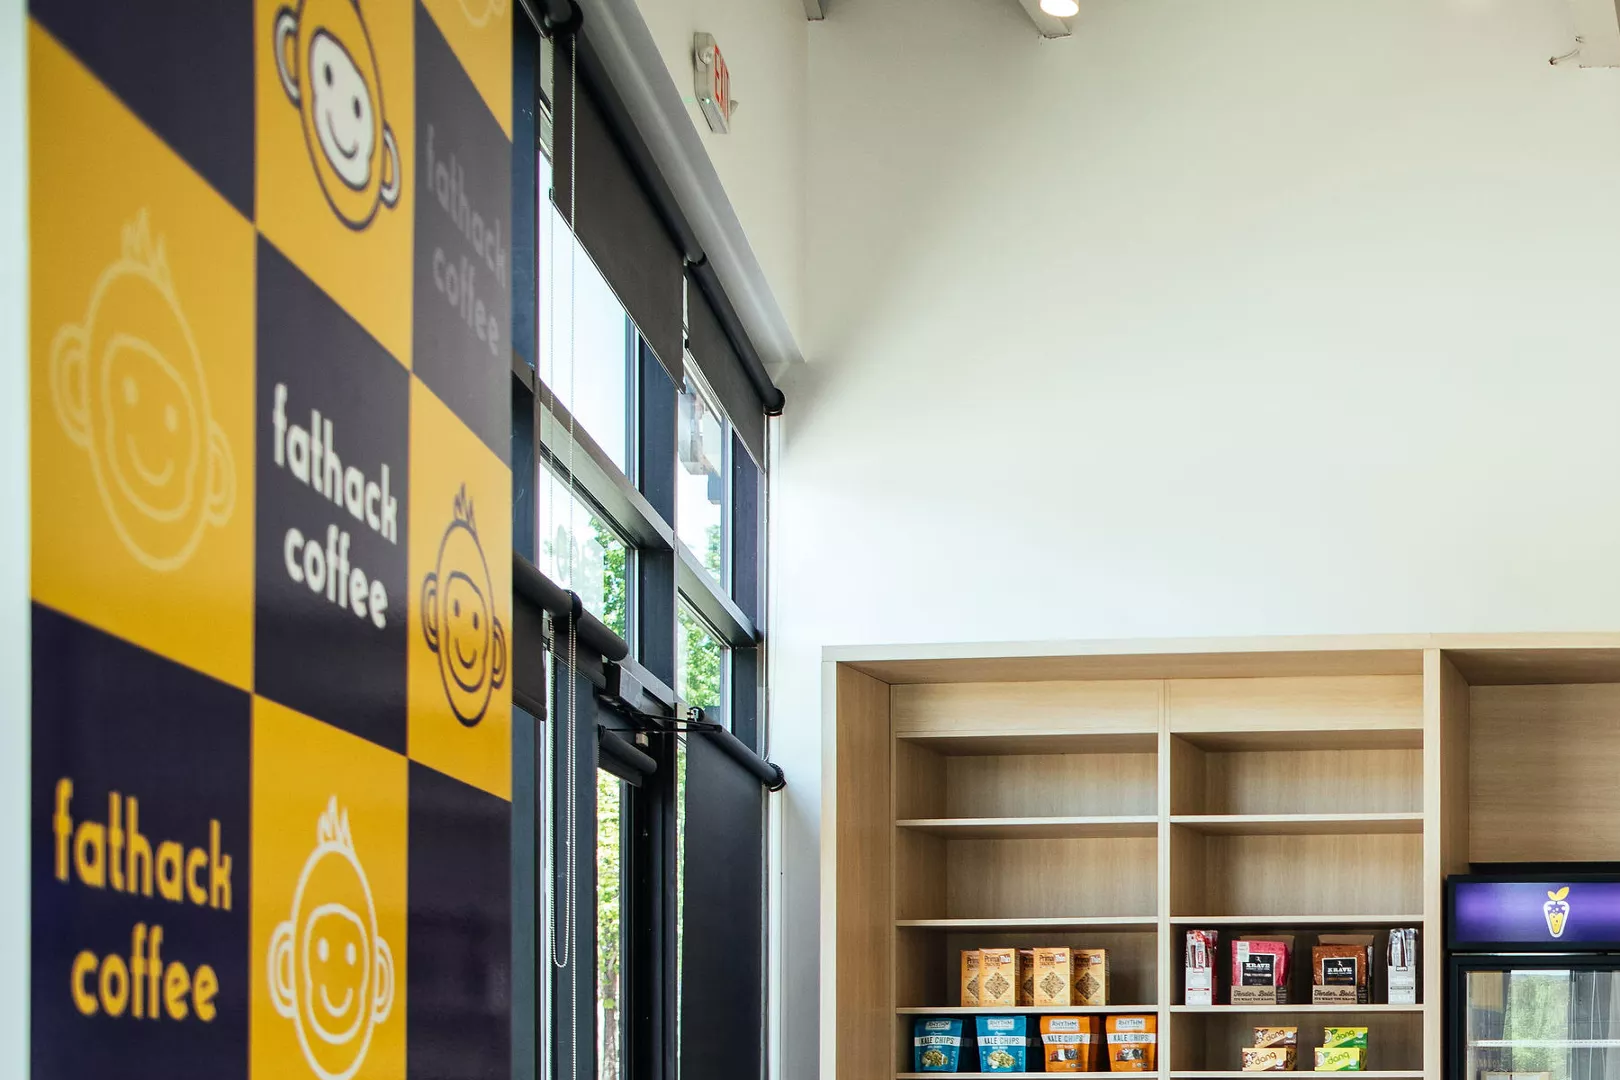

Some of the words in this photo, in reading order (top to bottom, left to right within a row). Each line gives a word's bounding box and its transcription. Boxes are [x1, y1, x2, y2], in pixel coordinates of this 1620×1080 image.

[426, 122, 506, 289] fathack
[432, 246, 499, 356] coffee
[273, 382, 398, 546] fathack
[284, 523, 389, 629] coffee
[53, 776, 233, 912] fathack
[71, 921, 220, 1022] coffee
[920, 1036, 933, 1045] KALE
[935, 1036, 955, 1045] CHIPS
[984, 1037, 997, 1045] KALE
[999, 1037, 1020, 1045] CHIPS
[1047, 1035, 1061, 1043] KALE
[1063, 1034, 1083, 1043] CHIPS
[1113, 1034, 1127, 1042] KALE
[1130, 1034, 1150, 1042] CHIPS
[1266, 1029, 1285, 1042] dang
[1336, 1029, 1355, 1041] dang
[1255, 1051, 1277, 1065] dang
[1328, 1051, 1350, 1065] dang
